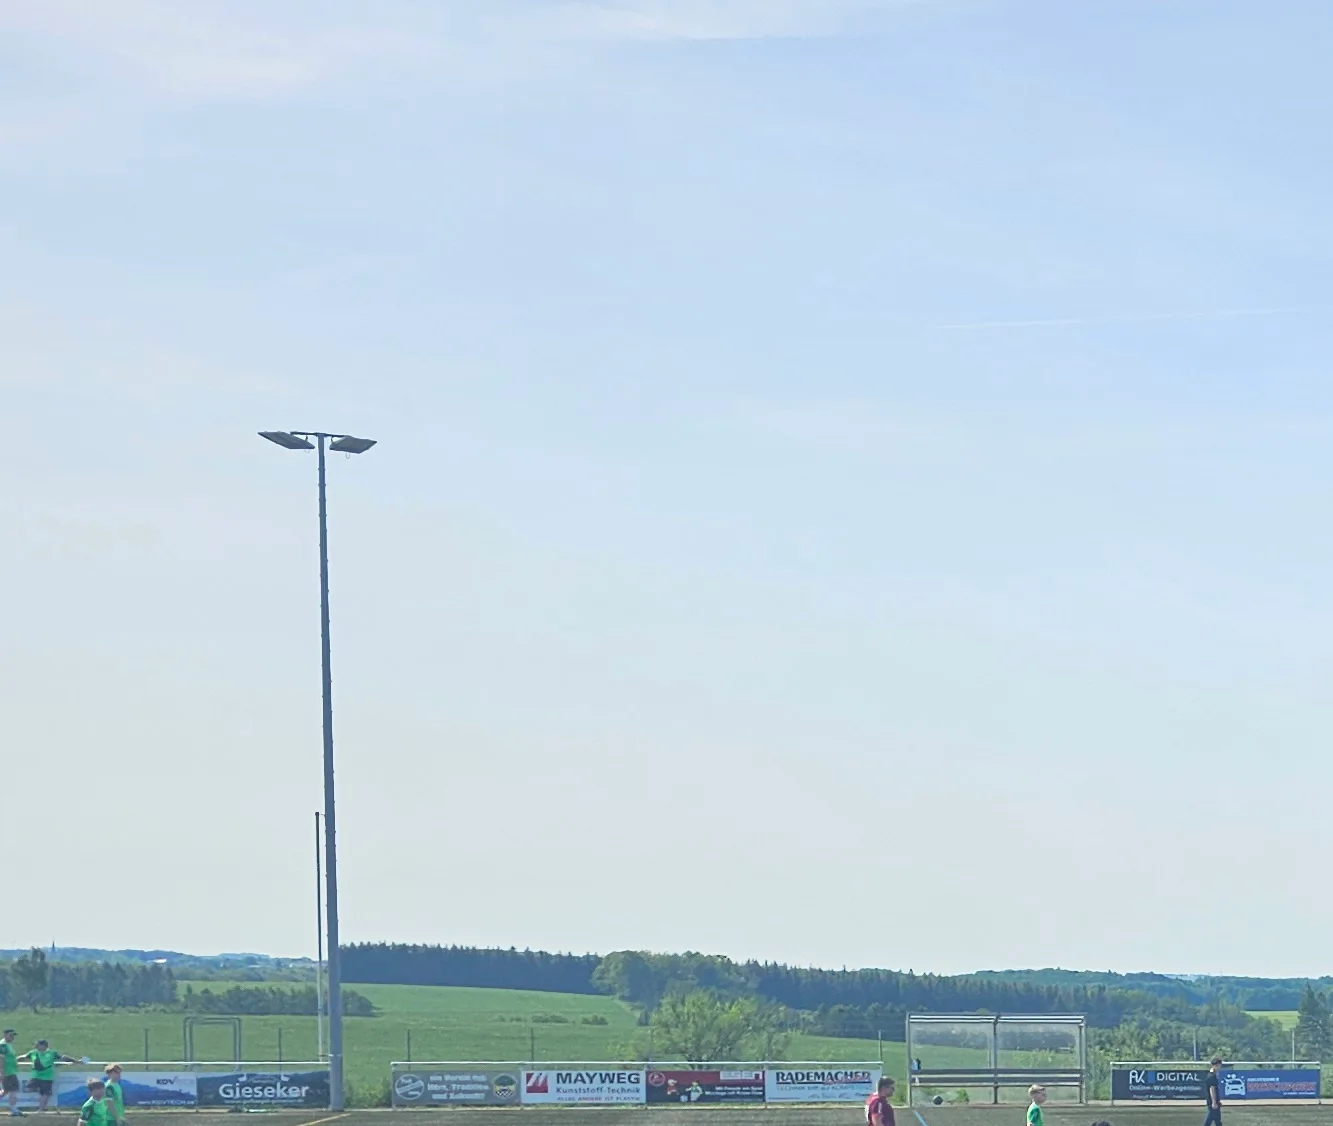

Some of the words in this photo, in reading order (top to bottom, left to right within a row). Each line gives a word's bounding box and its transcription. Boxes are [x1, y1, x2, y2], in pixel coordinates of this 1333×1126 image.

[556, 1072, 641, 1085] MAYWEG
[776, 1071, 871, 1083] RADEMACHER
[1156, 1072, 1202, 1082] DIGITAL
[218, 1082, 310, 1099] Gieseker
[556, 1086, 641, 1095] Kunststoff-Technik
